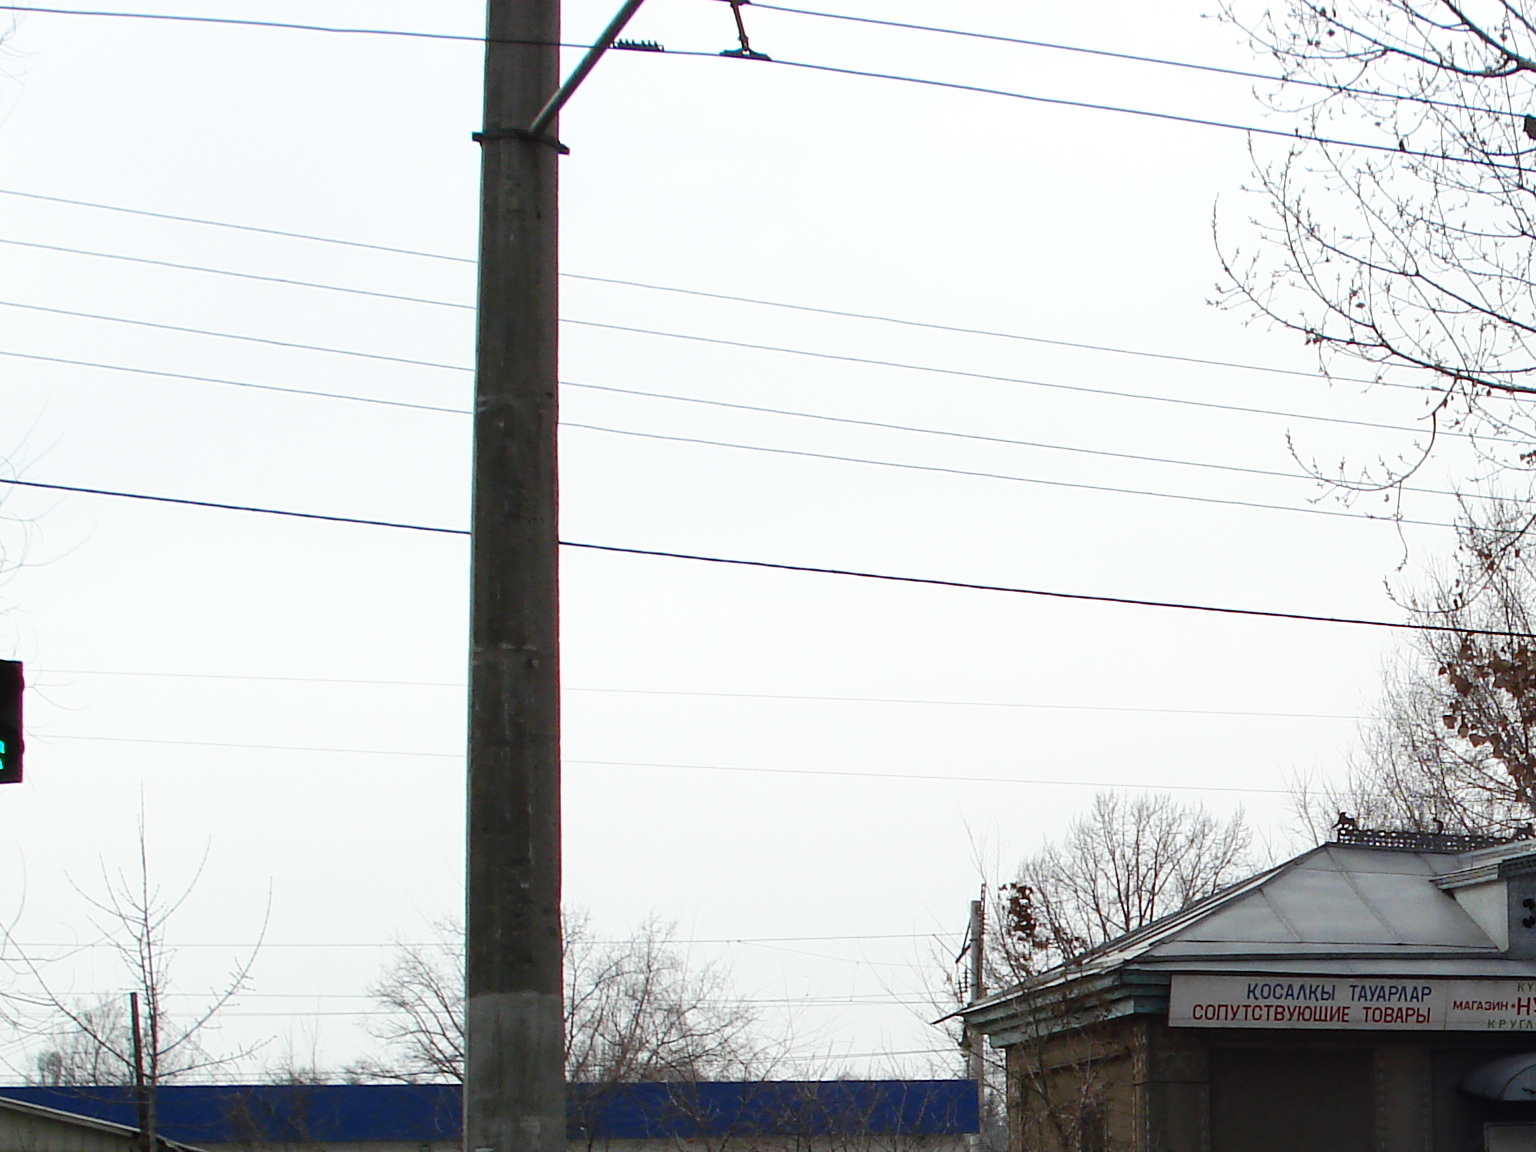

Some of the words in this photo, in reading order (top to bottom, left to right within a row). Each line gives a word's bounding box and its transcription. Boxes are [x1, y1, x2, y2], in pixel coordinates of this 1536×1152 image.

[1349, 985, 1432, 1003] ТАУАРЛАР
[1362, 1006, 1431, 1024] ТОВАРЫ
[1452, 1000, 1508, 1012] МАГАЗИН
